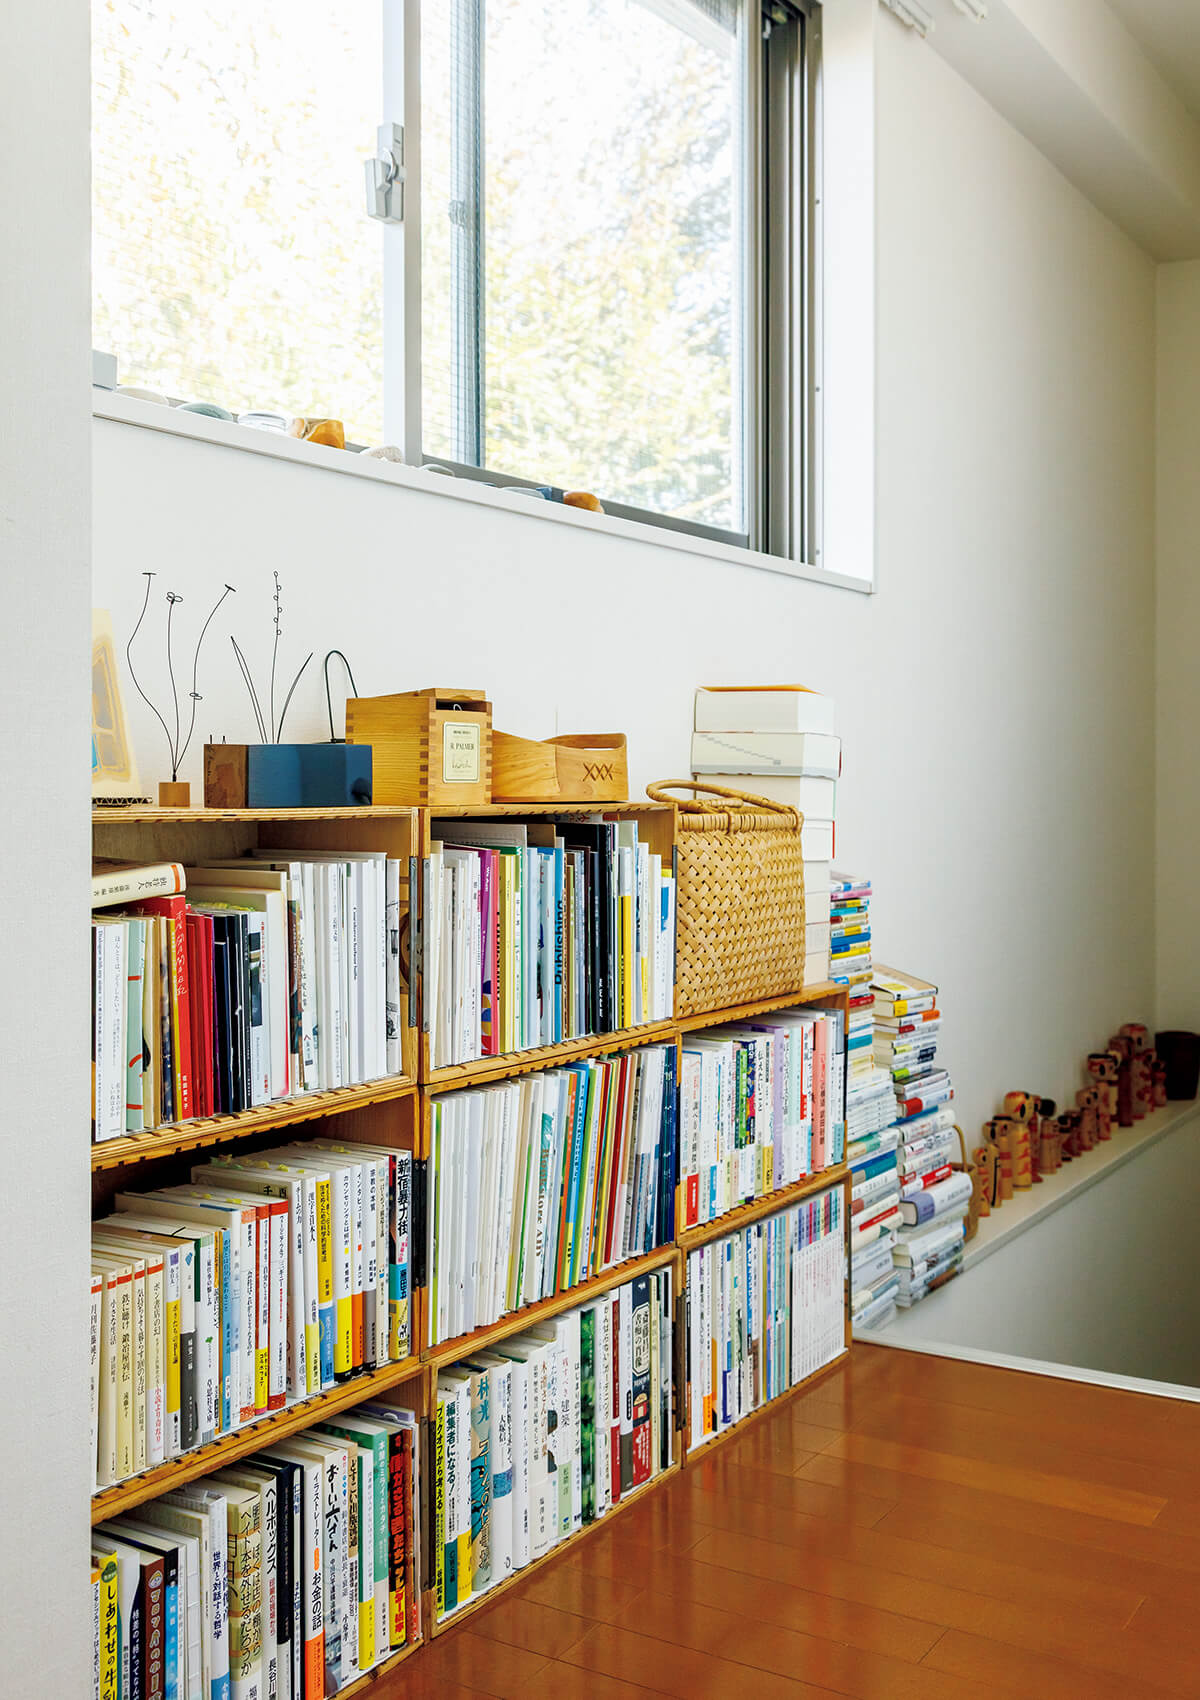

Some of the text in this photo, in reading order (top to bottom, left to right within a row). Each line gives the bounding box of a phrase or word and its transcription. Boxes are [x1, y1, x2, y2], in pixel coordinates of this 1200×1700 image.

[554, 899, 563, 985] Publishing
[537, 1148, 550, 1224] Bookstore
[265, 1487, 277, 1575] ヘルボックス
[325, 1464, 341, 1552] おーい六さん
[213, 1551, 222, 1640] 世界と対話する哲学
[240, 1511, 252, 1677] ヘイト本を外せるだろうか
[311, 1573, 321, 1631] お金の話
